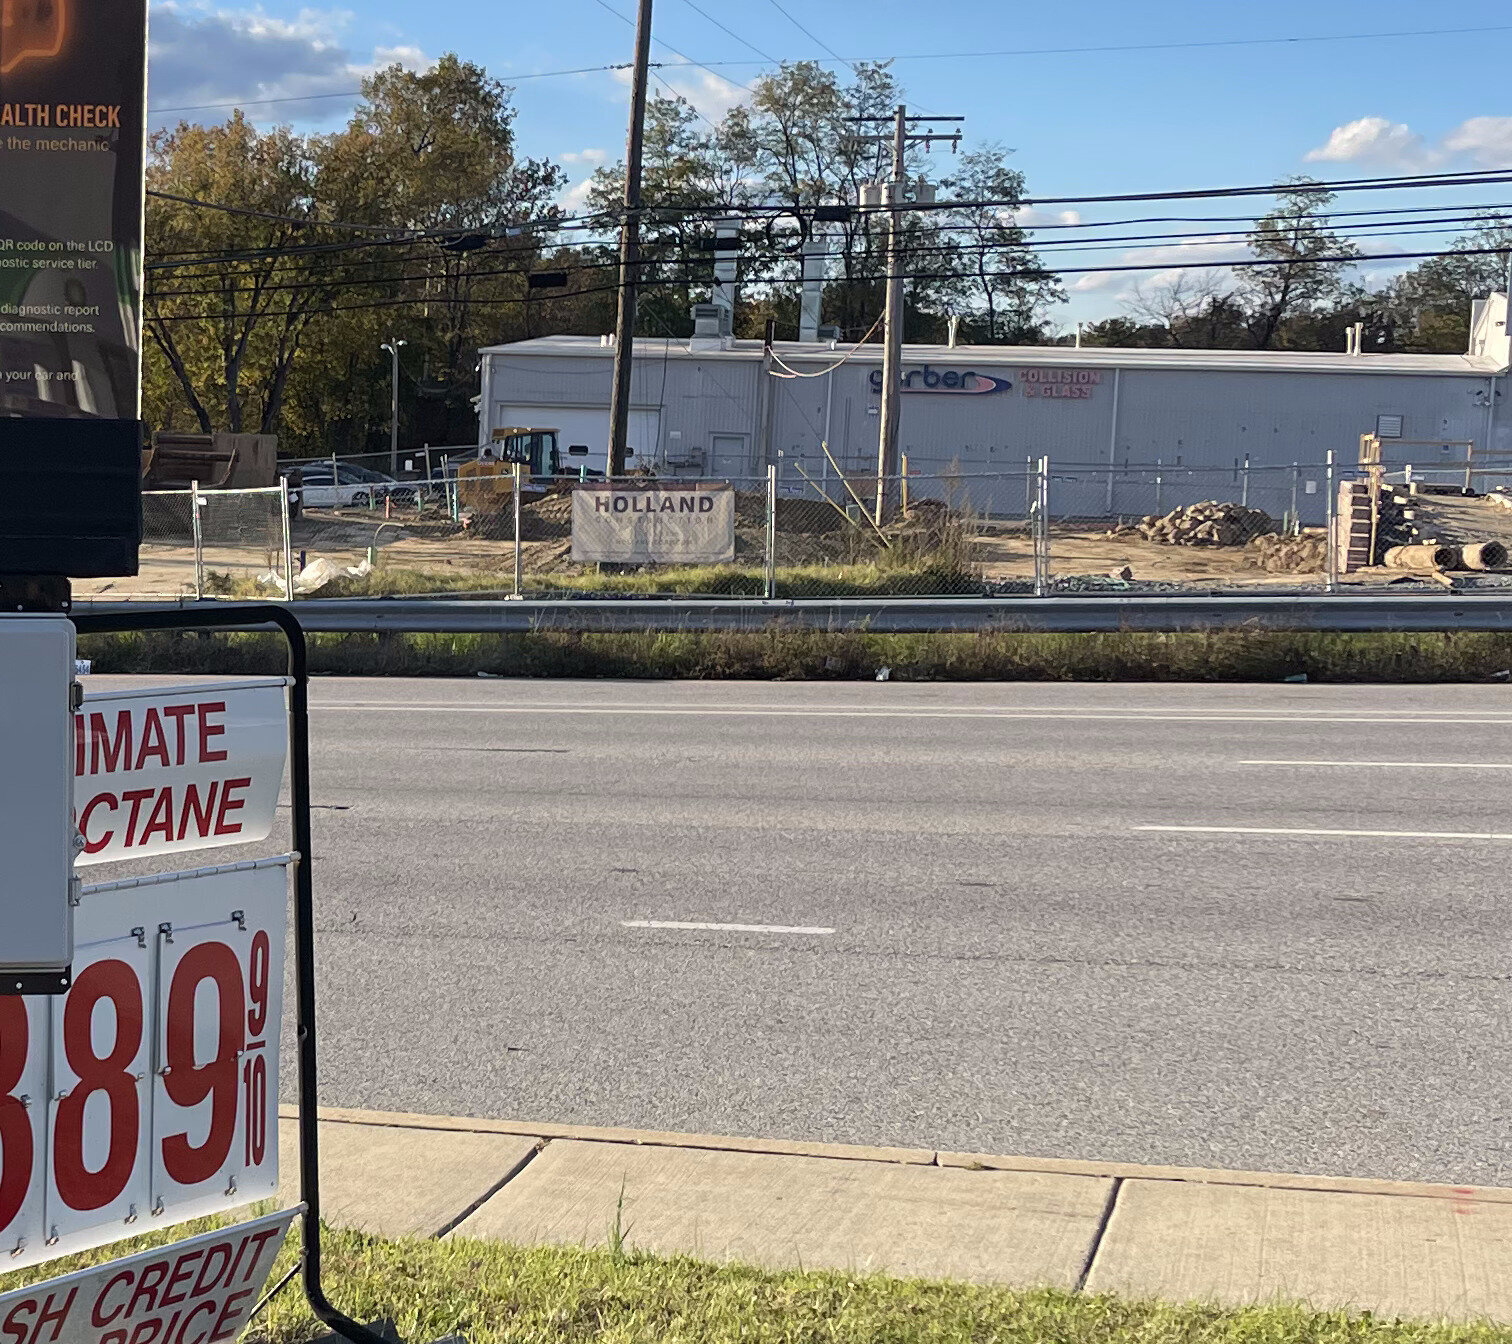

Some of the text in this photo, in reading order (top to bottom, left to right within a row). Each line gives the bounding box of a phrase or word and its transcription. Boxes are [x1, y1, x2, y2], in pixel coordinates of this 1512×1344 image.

[56, 104, 122, 128] CHECK
[7, 136, 31, 150] the
[36, 137, 109, 152] mechanic
[16, 239, 45, 251] code
[48, 242, 63, 251] on
[67, 240, 85, 252] the
[88, 240, 114, 252] LCD
[32, 258, 74, 269] service
[0, 304, 61, 317] diagnostic
[64, 305, 100, 317] report
[6, 371, 32, 382] your
[35, 371, 53, 380] car
[56, 370, 79, 380] and
[869, 364, 977, 394] grber
[1018, 368, 1101, 384] COLLISION
[1042, 384, 1090, 398] GLASS
[594, 495, 714, 513] HOLLAND
[73, 777, 252, 855] CTANE
[91, 1227, 281, 1329] CREDIT
